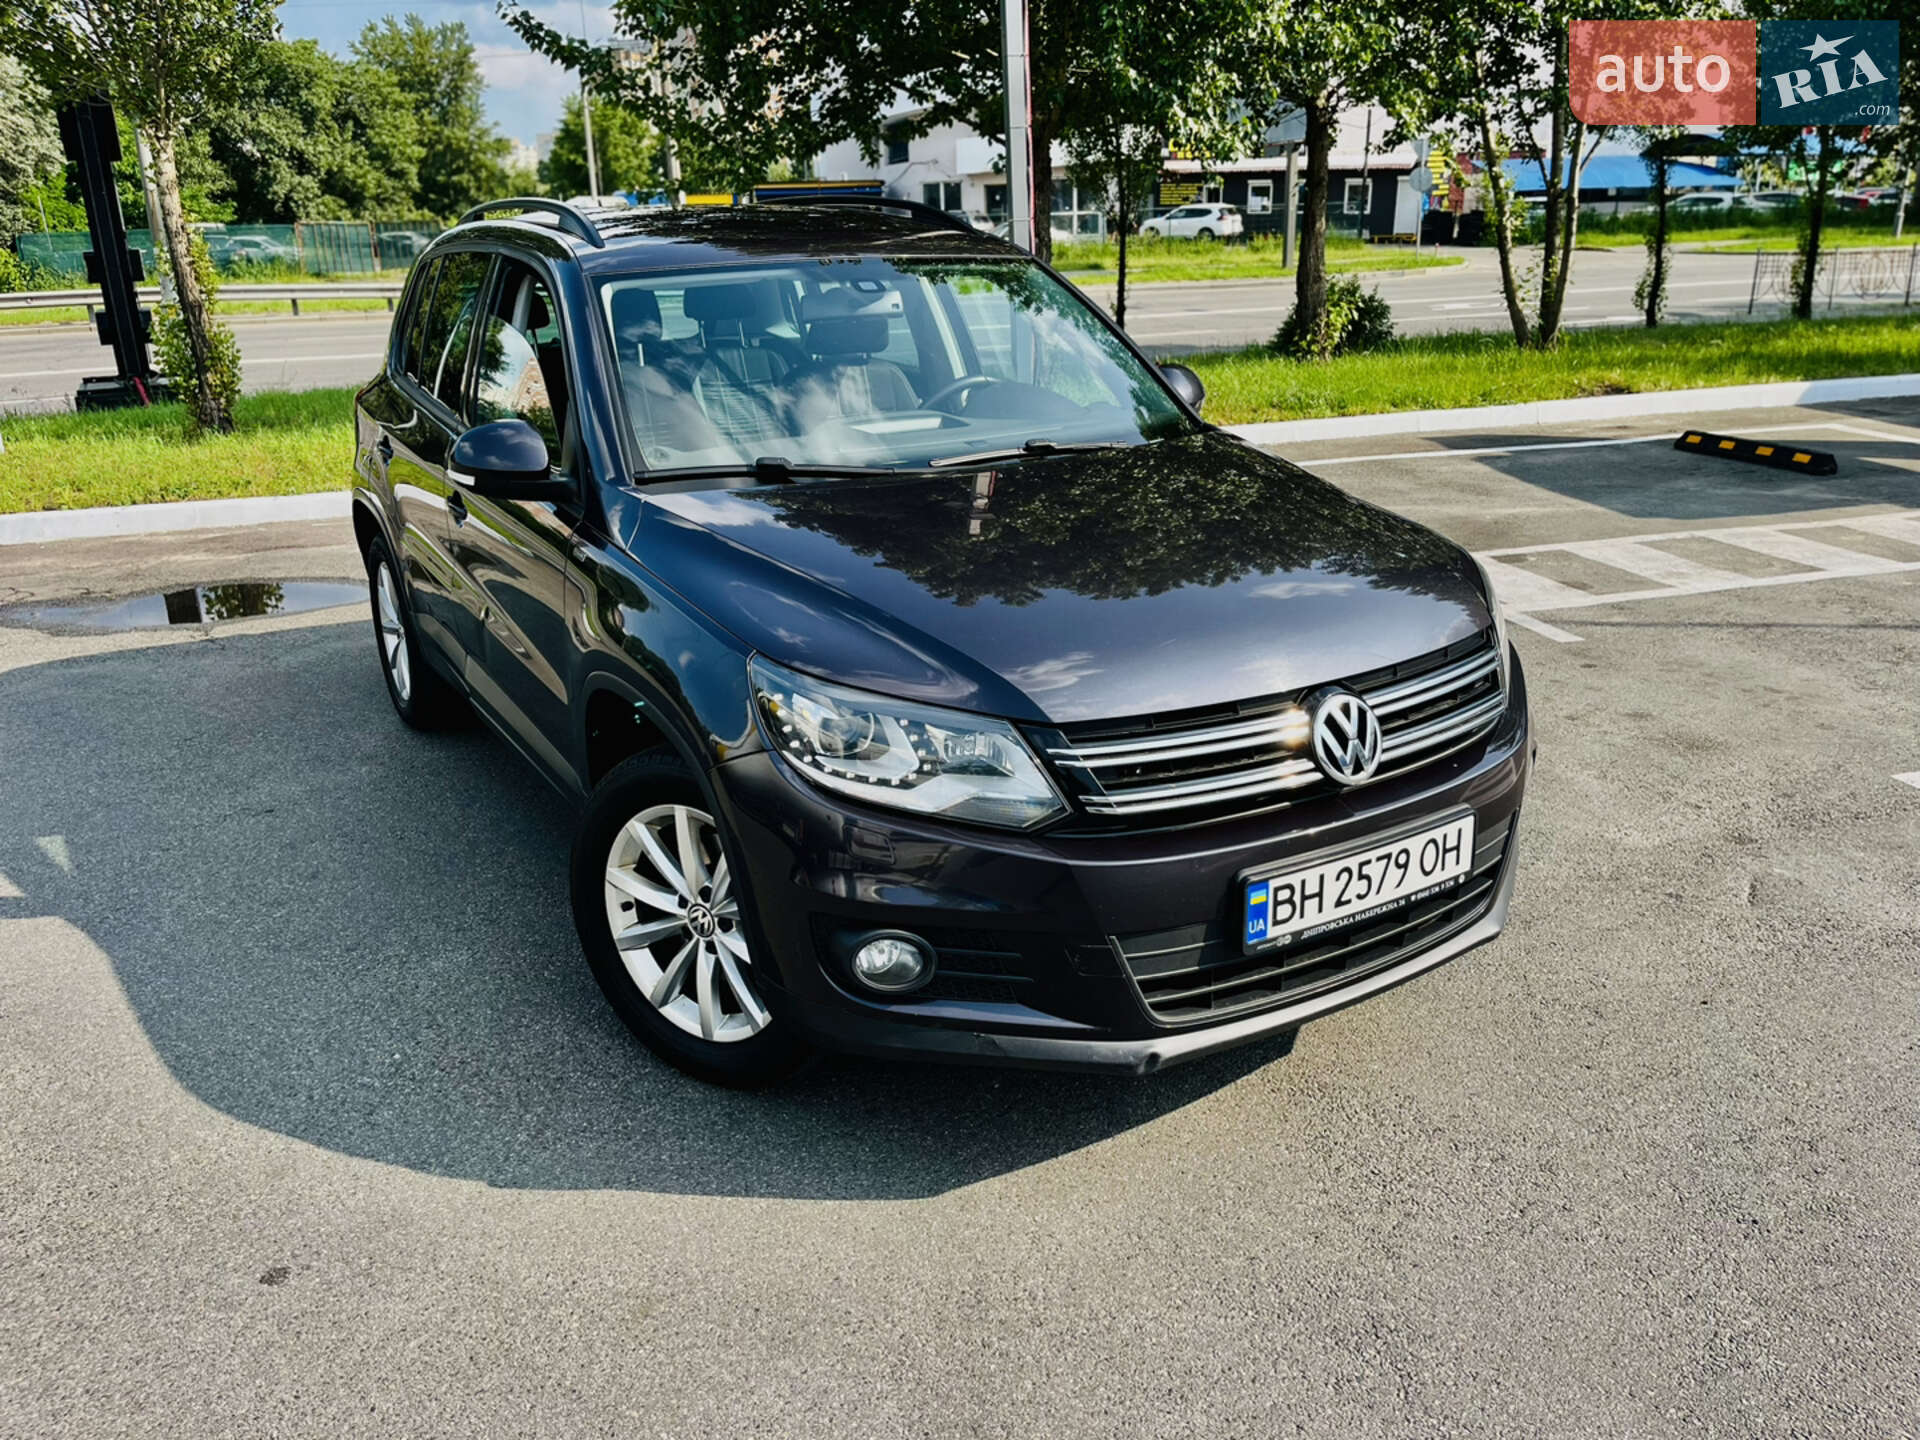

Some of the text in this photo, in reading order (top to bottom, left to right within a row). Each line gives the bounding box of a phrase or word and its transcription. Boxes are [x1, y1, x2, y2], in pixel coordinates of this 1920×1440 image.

[1272, 874, 1325, 927] BH
[1334, 848, 1410, 908] 2579
[1420, 828, 1462, 877] OH
[1249, 920, 1265, 933] UA
